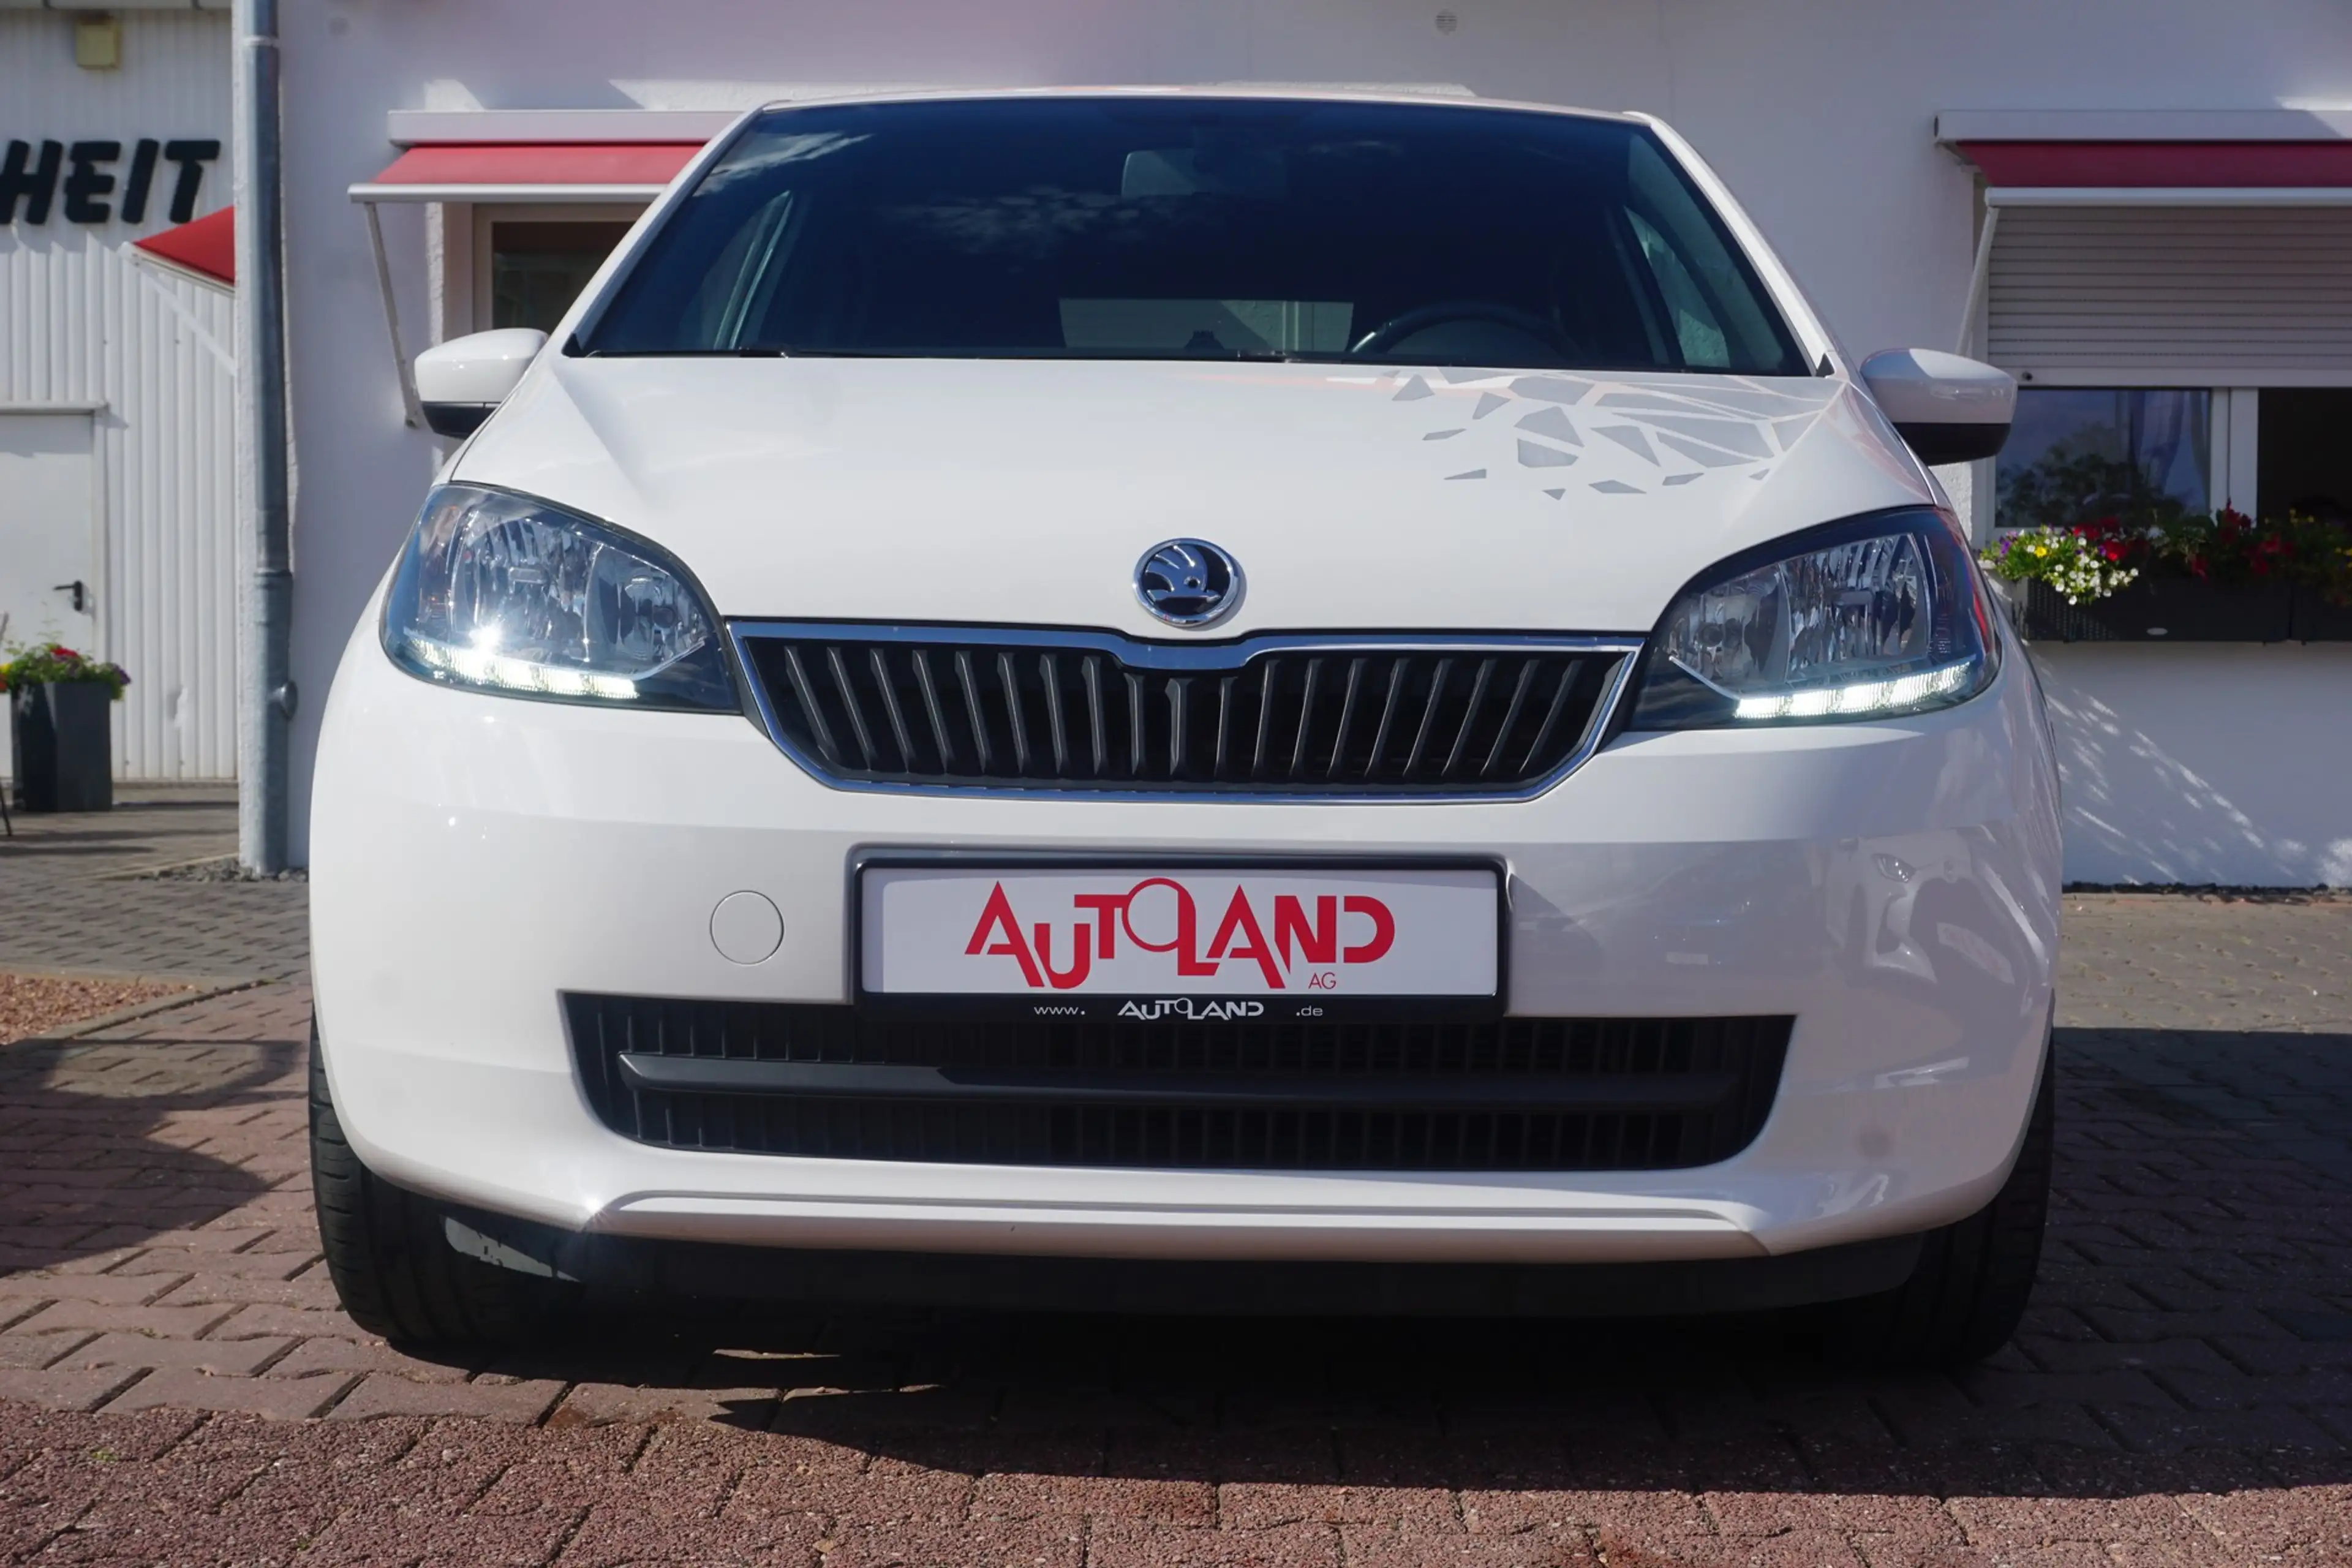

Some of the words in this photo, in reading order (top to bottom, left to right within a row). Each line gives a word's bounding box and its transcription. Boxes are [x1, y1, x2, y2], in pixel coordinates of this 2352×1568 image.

[0, 138, 221, 225] HEIT
[965, 876, 1395, 989] AUTOLAND
[1308, 971, 1336, 990] AG
[1117, 997, 1264, 1021] AUTOLAND
[1295, 1005, 1324, 1017] .de
